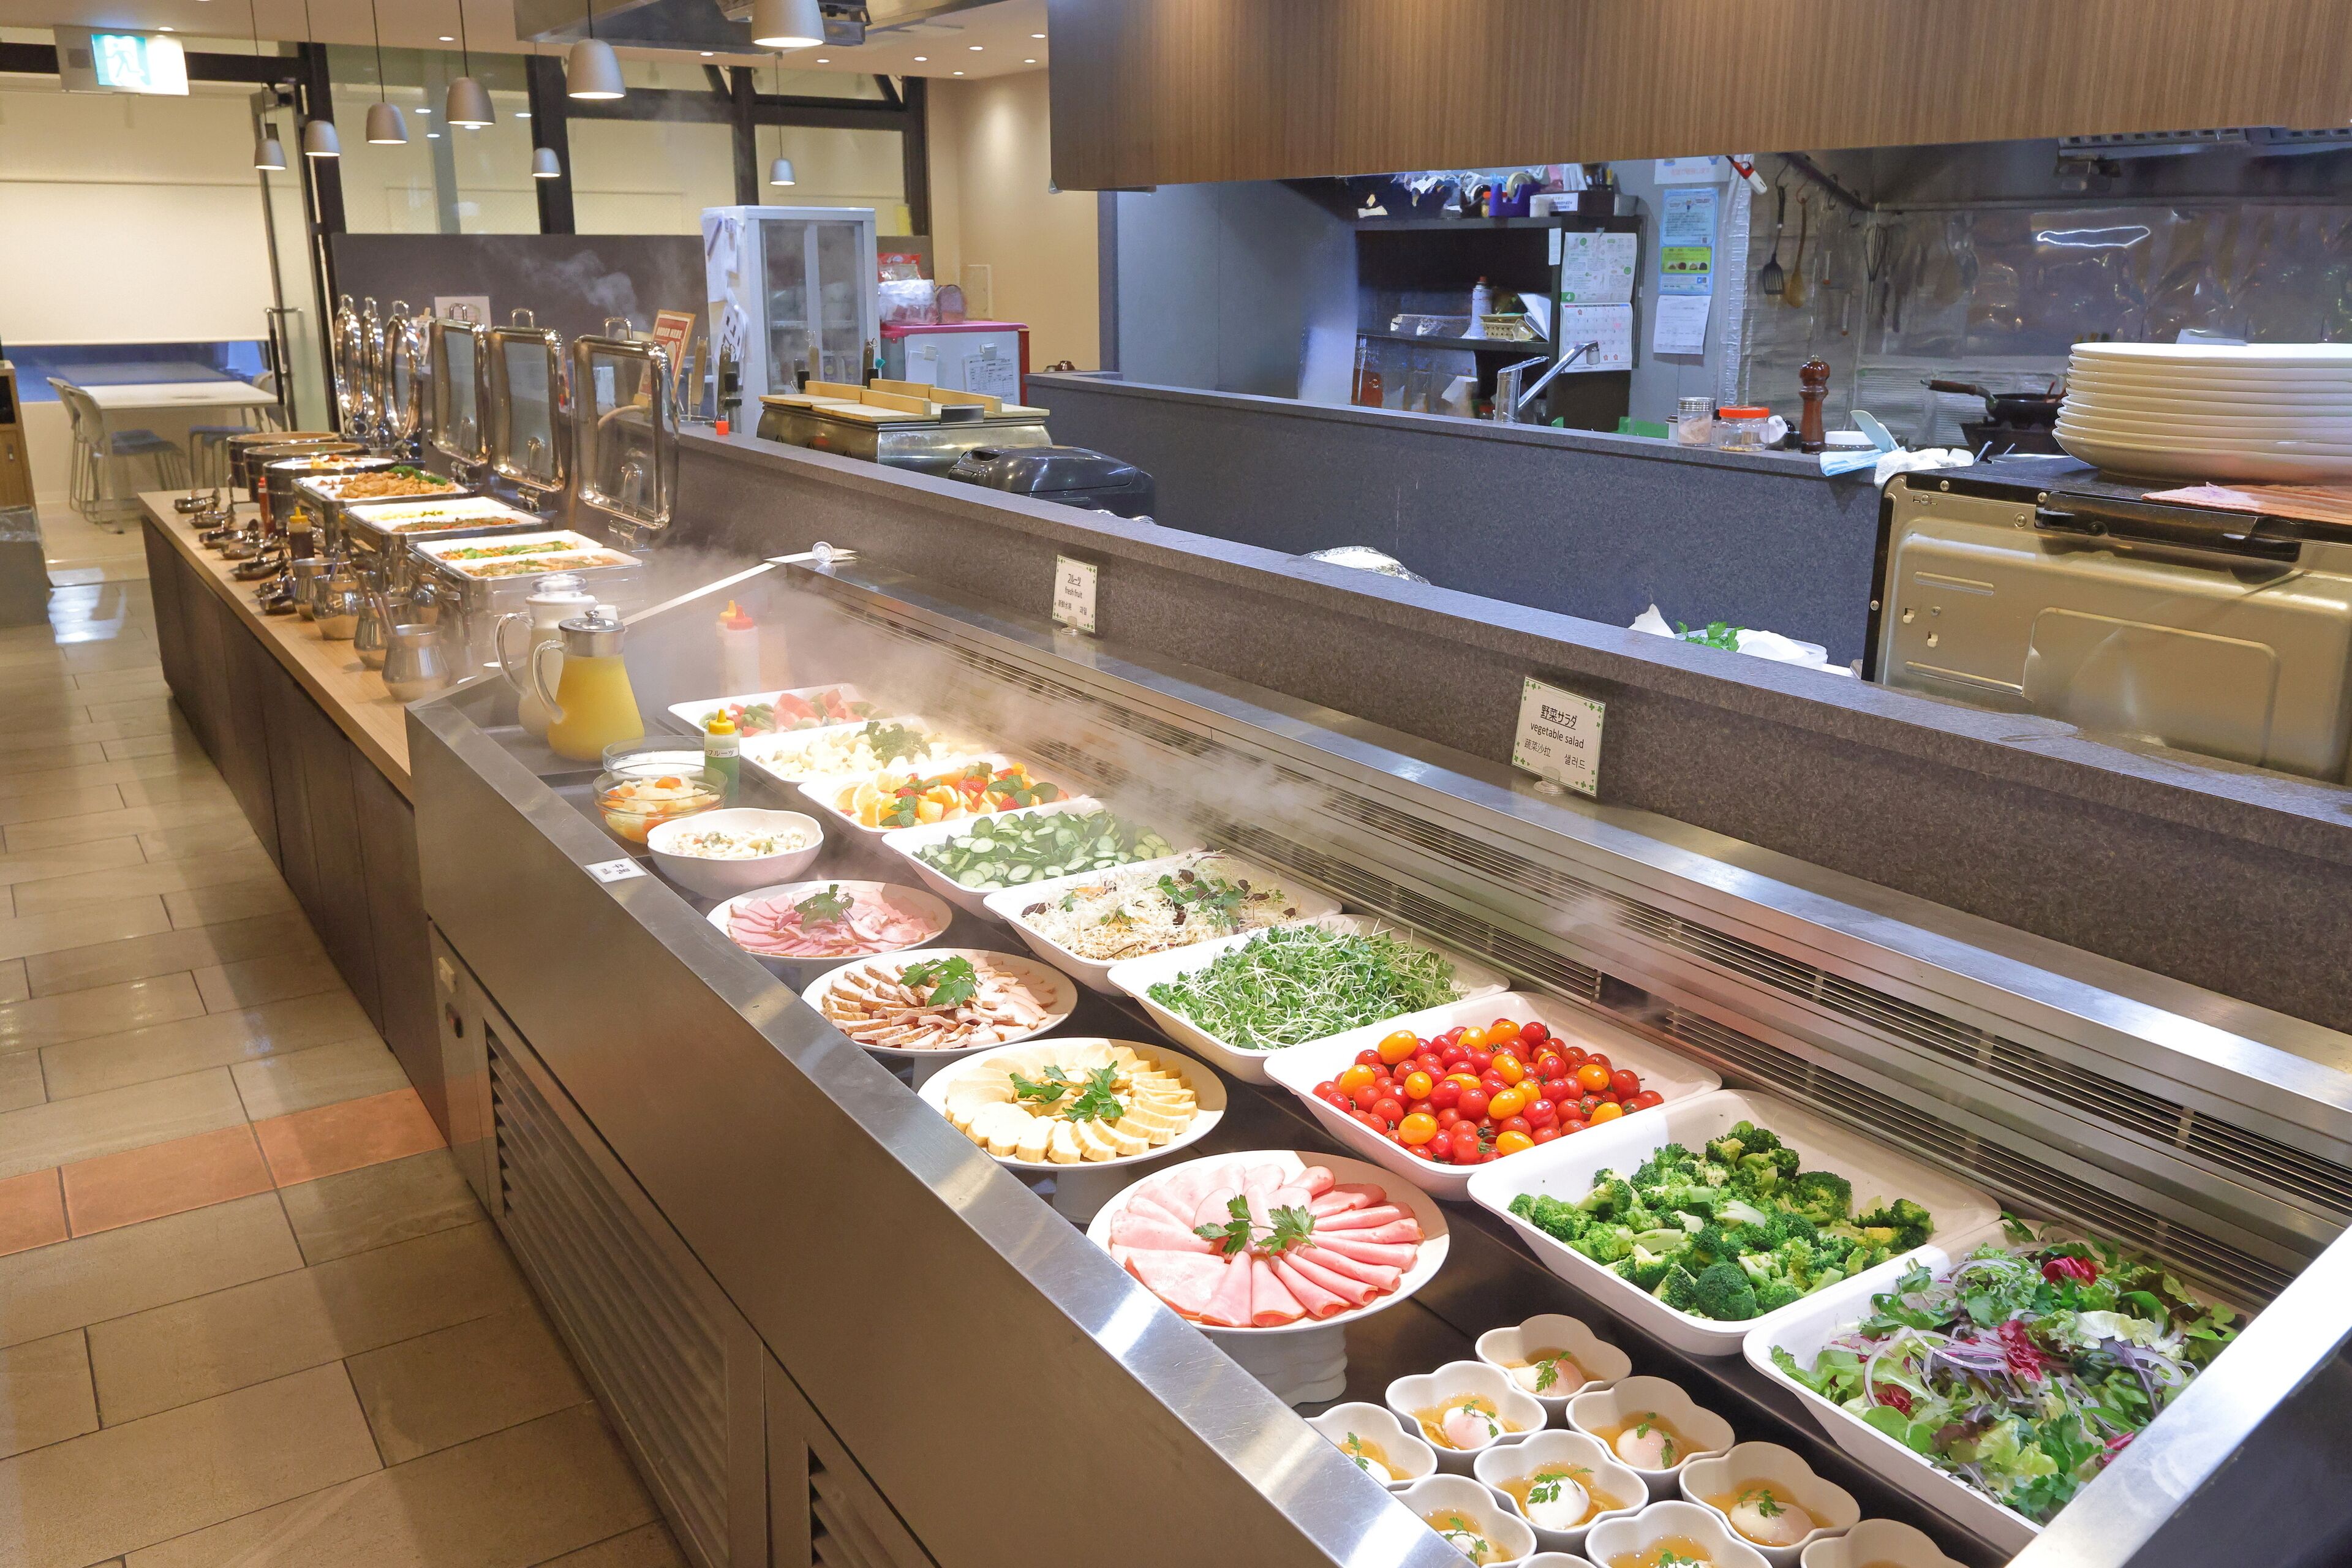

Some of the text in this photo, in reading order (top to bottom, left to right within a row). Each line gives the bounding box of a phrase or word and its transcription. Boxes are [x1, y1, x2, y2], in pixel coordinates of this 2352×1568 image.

[1068, 573, 1081, 585] フルーツ
[1065, 586, 1074, 595] fresh
[1540, 704, 1578, 729] 野菜サラダ
[1530, 722, 1585, 749] vegetable salad
[1523, 737, 1551, 758] 蔬菜沙拉
[1564, 753, 1586, 770] 샐러드
